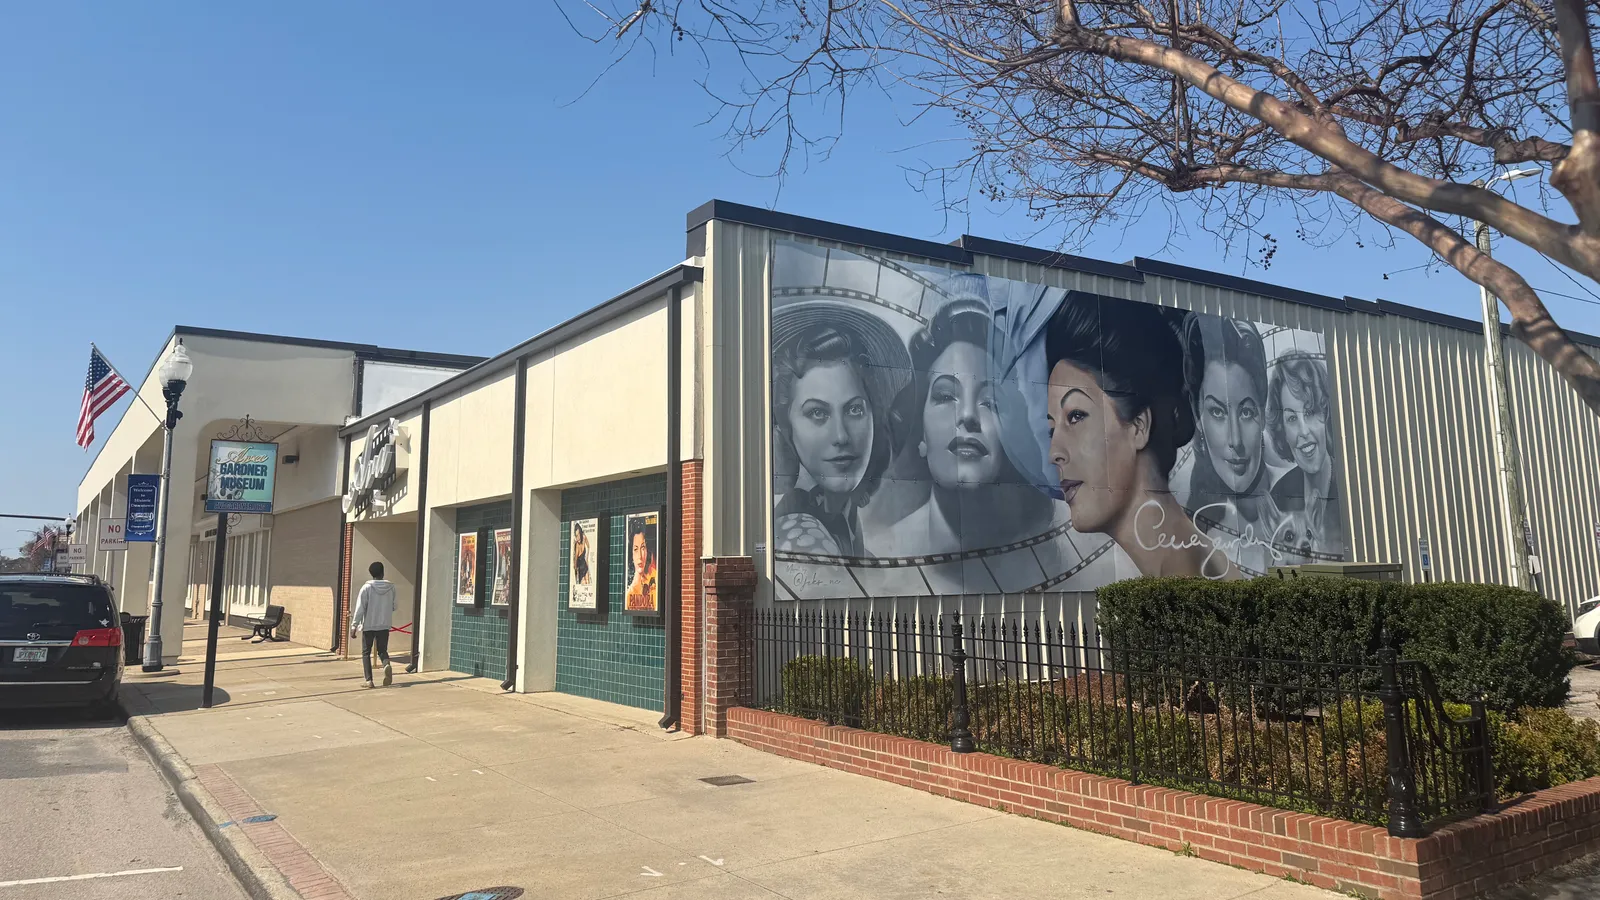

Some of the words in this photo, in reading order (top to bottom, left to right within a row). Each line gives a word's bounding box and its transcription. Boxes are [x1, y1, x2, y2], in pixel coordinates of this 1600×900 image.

[216, 446, 269, 464] Ava
[220, 462, 268, 477] GARDNER
[220, 476, 265, 491] MUSEUM
[108, 525, 121, 534] NO
[629, 594, 654, 607] PANDORA
